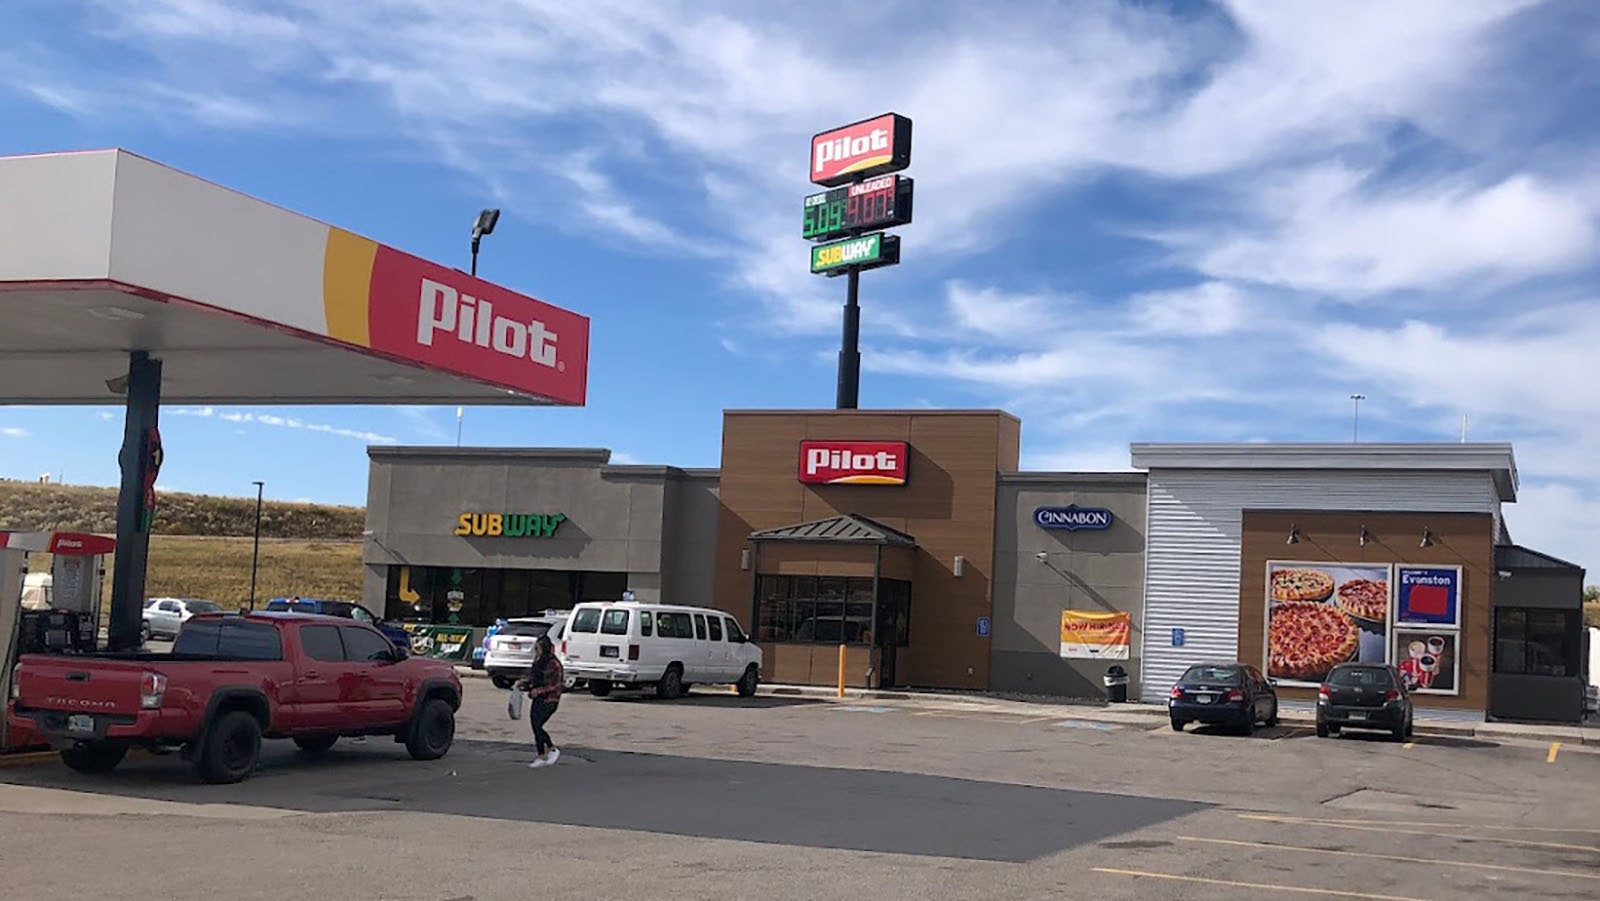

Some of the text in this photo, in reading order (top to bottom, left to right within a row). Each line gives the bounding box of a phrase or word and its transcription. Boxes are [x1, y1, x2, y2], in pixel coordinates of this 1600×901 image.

[815, 129, 888, 173] Pilot
[851, 177, 892, 197] UNLEADED
[816, 238, 876, 267] SUBWAY
[417, 278, 558, 368] Pilot
[807, 448, 897, 475] Pilot
[454, 512, 567, 538] SUBWAY
[1038, 510, 1107, 525] CINNABON
[1402, 574, 1451, 585] Evanston
